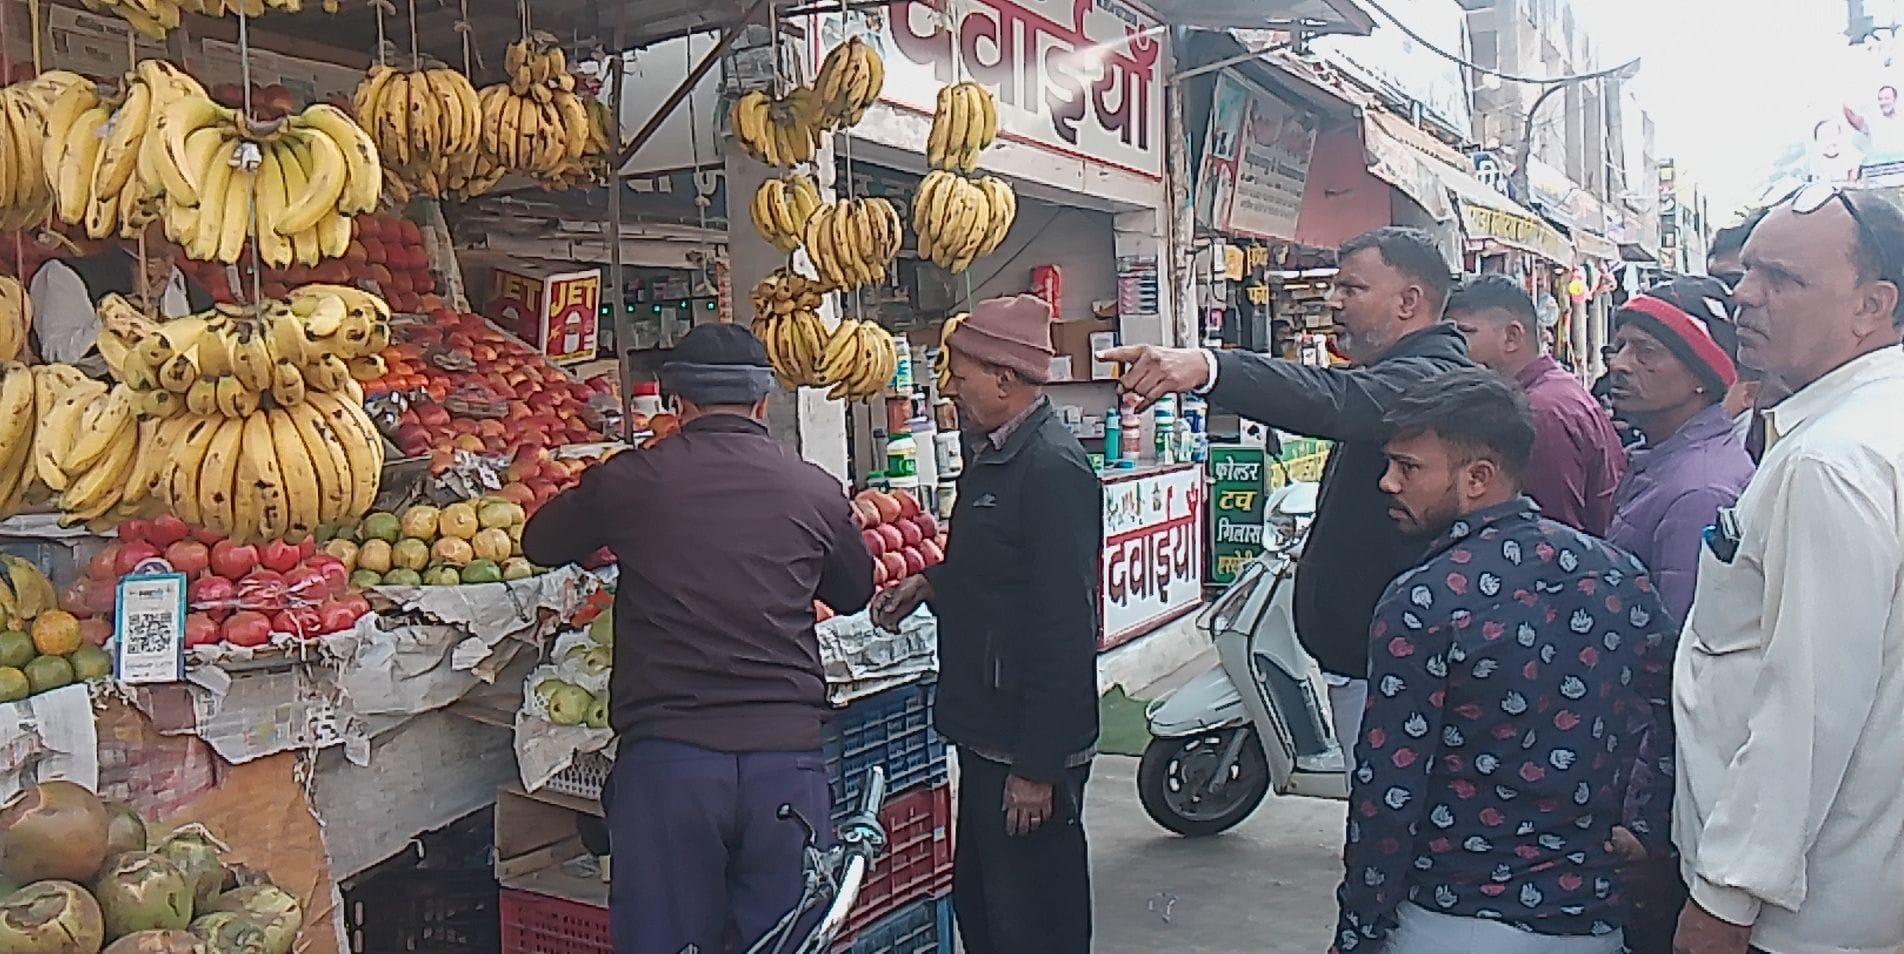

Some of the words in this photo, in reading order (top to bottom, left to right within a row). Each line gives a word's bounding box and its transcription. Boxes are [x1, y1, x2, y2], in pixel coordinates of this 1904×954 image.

[486, 270, 542, 312] JET
[550, 276, 598, 318] JET
[1215, 456, 1260, 481] फोल्डर
[1219, 490, 1258, 511] टच
[1216, 516, 1263, 544] गिलास
